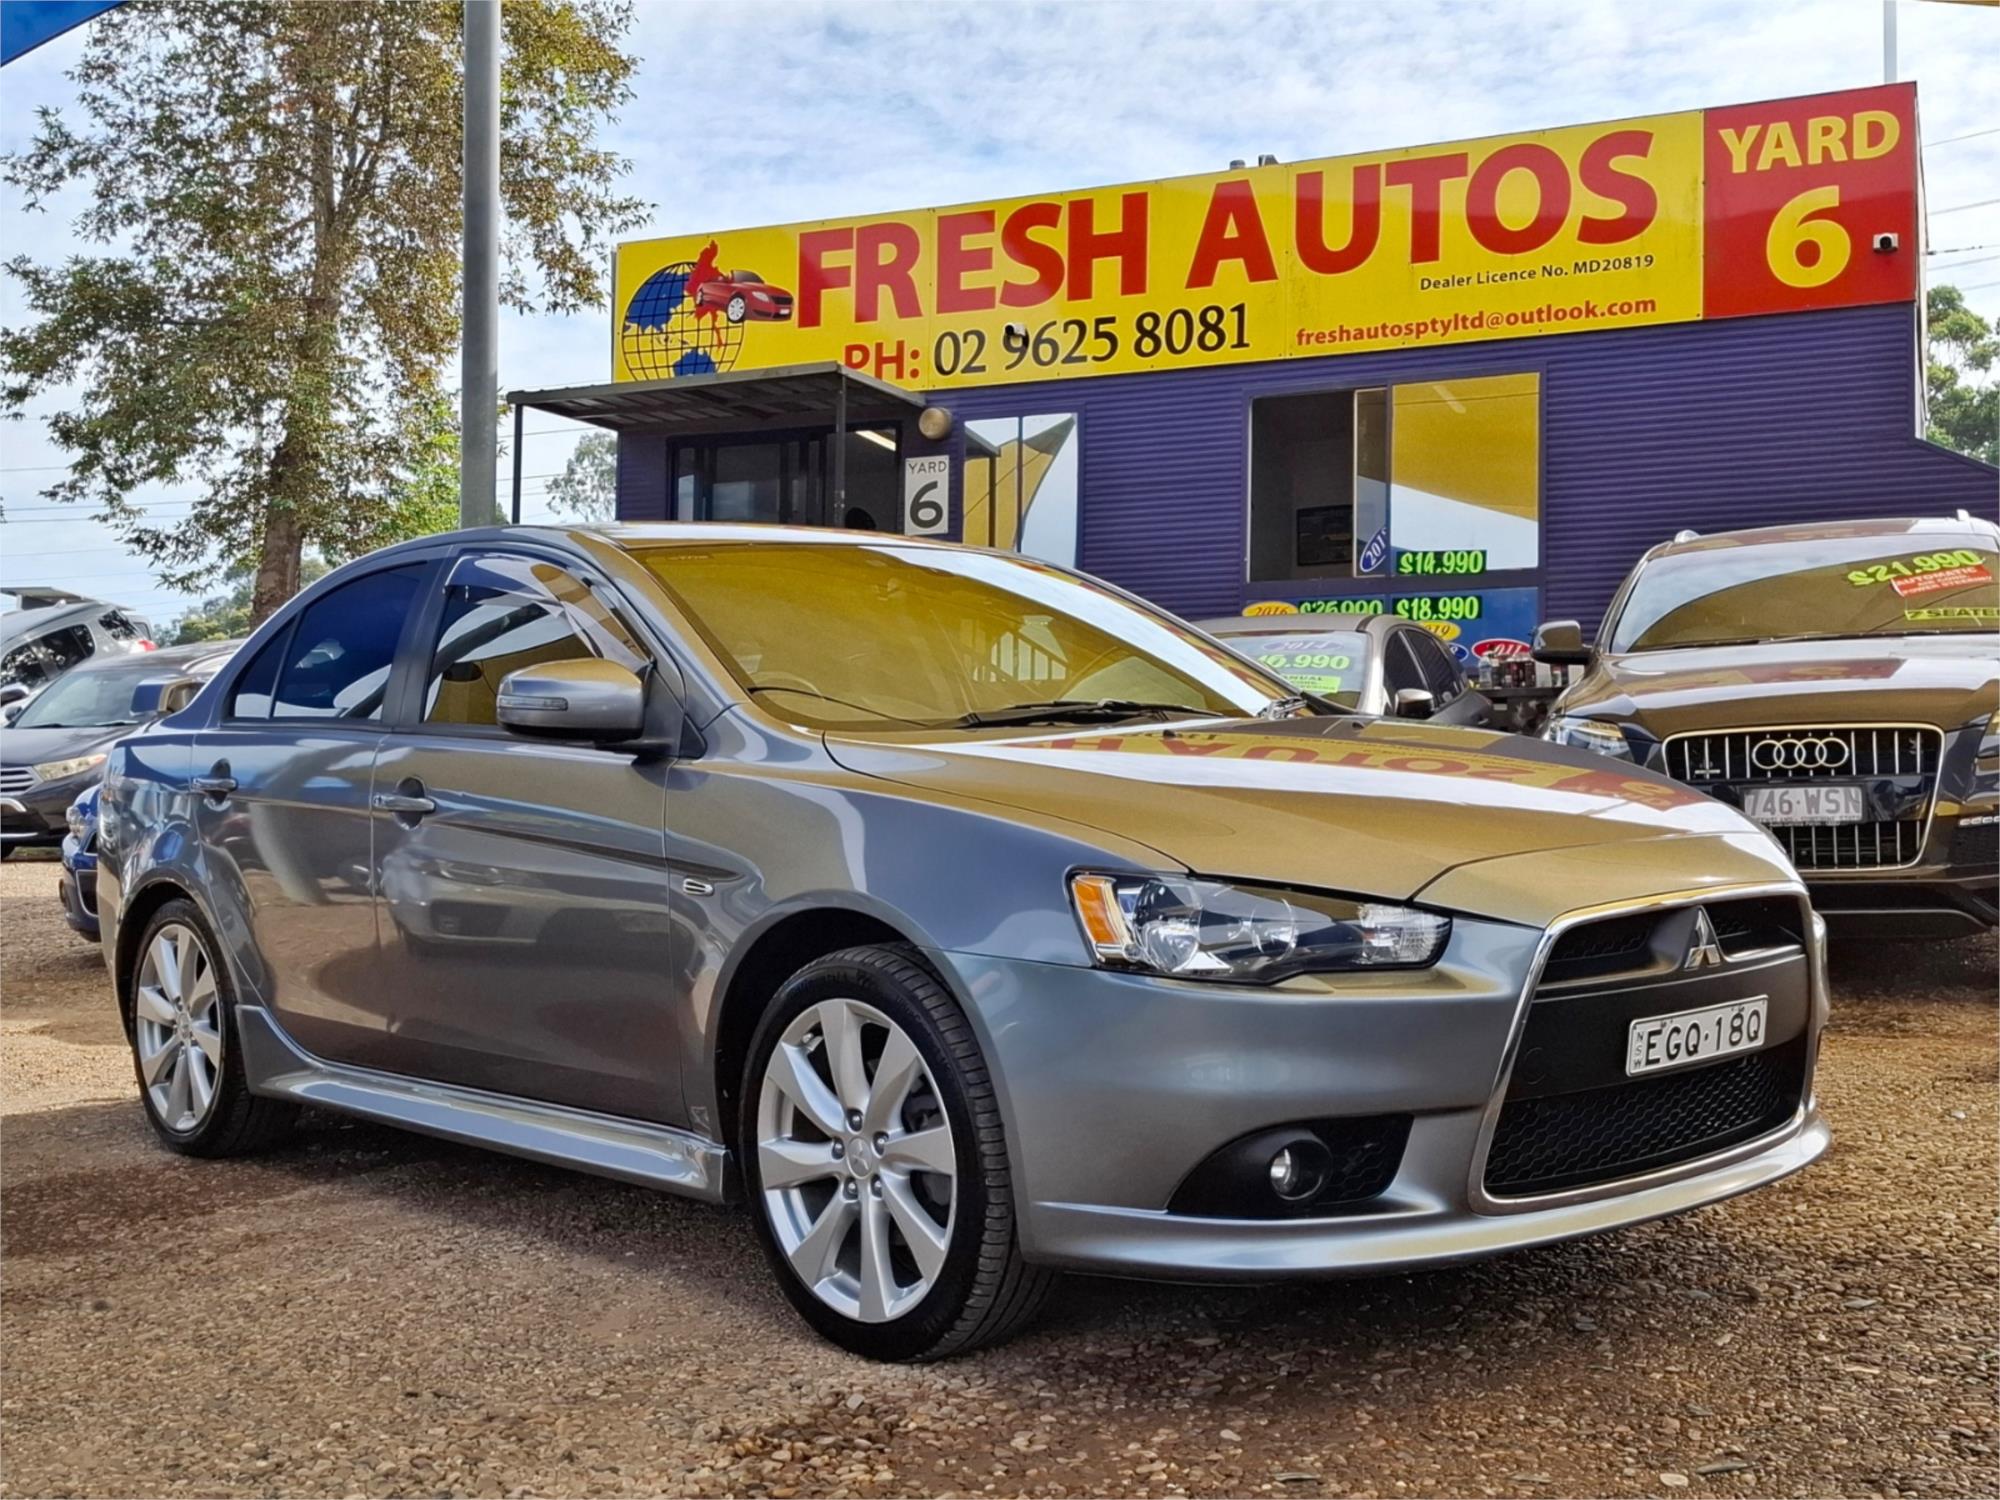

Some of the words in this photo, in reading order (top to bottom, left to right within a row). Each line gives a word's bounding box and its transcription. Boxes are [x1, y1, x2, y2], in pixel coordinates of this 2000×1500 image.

[1719, 110, 1900, 174] YARD
[797, 192, 1148, 328] FRESH
[1185, 130, 1658, 289] AUTOS
[1766, 186, 1852, 288] 6
[1420, 272, 1472, 290] Dealer
[1477, 269, 1537, 285] Licence
[1541, 263, 1568, 278] No.
[1573, 254, 1655, 274] MD20819
[843, 339, 921, 380] PH:
[933, 328, 987, 377] 02
[1002, 315, 1119, 371] 9625
[1134, 302, 1251, 358] 8081
[1296, 298, 1657, 346] freshautosptyltd@outlook.com
[908, 460, 947, 475] YARD
[910, 480, 943, 529] 6
[1926, 607, 2000, 617] SEATE
